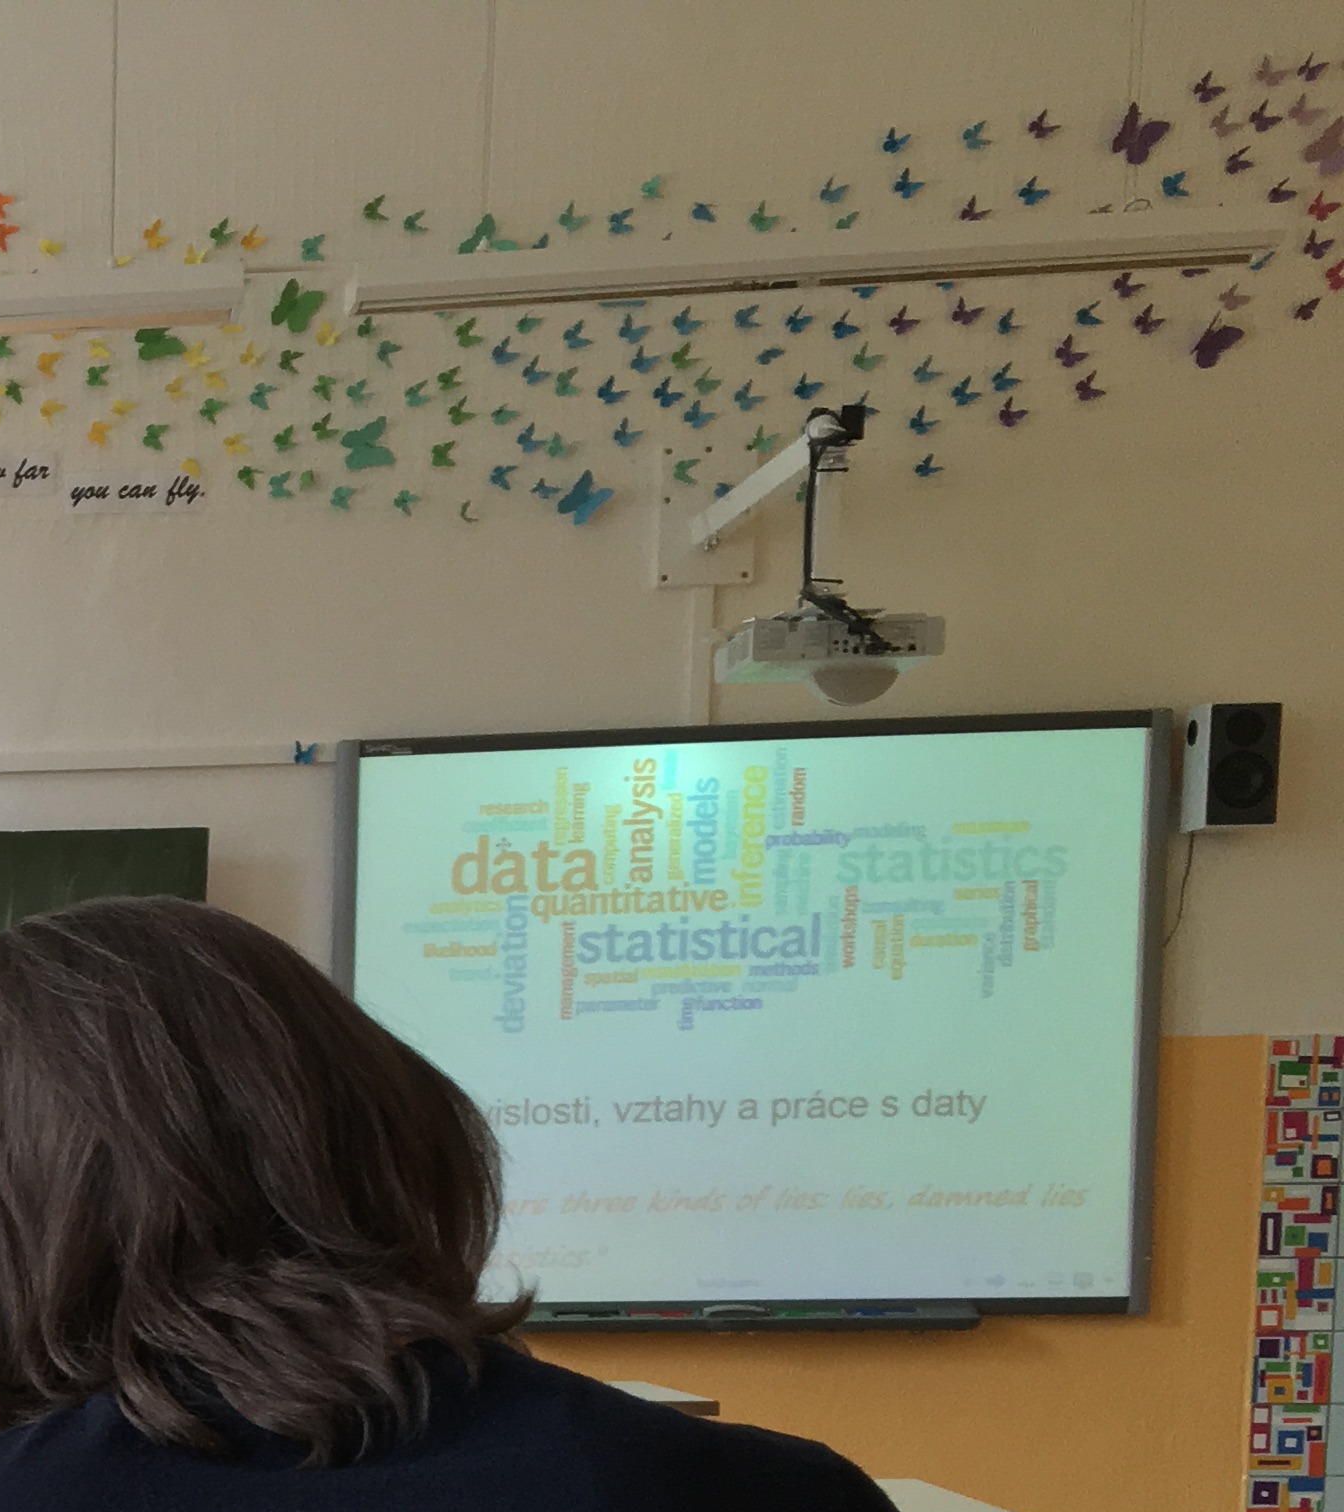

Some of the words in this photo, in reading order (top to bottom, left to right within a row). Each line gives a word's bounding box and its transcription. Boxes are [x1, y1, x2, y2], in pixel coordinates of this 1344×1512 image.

[12, 458, 50, 489] far
[71, 485, 110, 507] you
[118, 484, 158, 499] can
[165, 475, 205, 506] fly.
[623, 757, 663, 883] analysis
[789, 768, 808, 827] random
[604, 805, 622, 885] computing
[687, 777, 720, 885] models
[731, 765, 768, 908] inference
[836, 835, 1068, 882] statistics
[451, 835, 598, 895] data
[530, 882, 728, 923] quantitative
[840, 885, 860, 969] workshops
[494, 895, 529, 1033] deviation
[577, 912, 821, 963] statistical
[560, 921, 578, 1020] management
[614, 1094, 727, 1128] vztahy
[738, 1097, 758, 1122] a
[771, 1090, 868, 1126] práce
[881, 1095, 899, 1118] s
[912, 1089, 988, 1124] daty
[562, 1189, 639, 1214] three
[647, 1187, 728, 1213] kinds
[736, 1184, 772, 1211] of
[907, 1182, 1034, 1208] damned
[1041, 1182, 1090, 1209] lies
